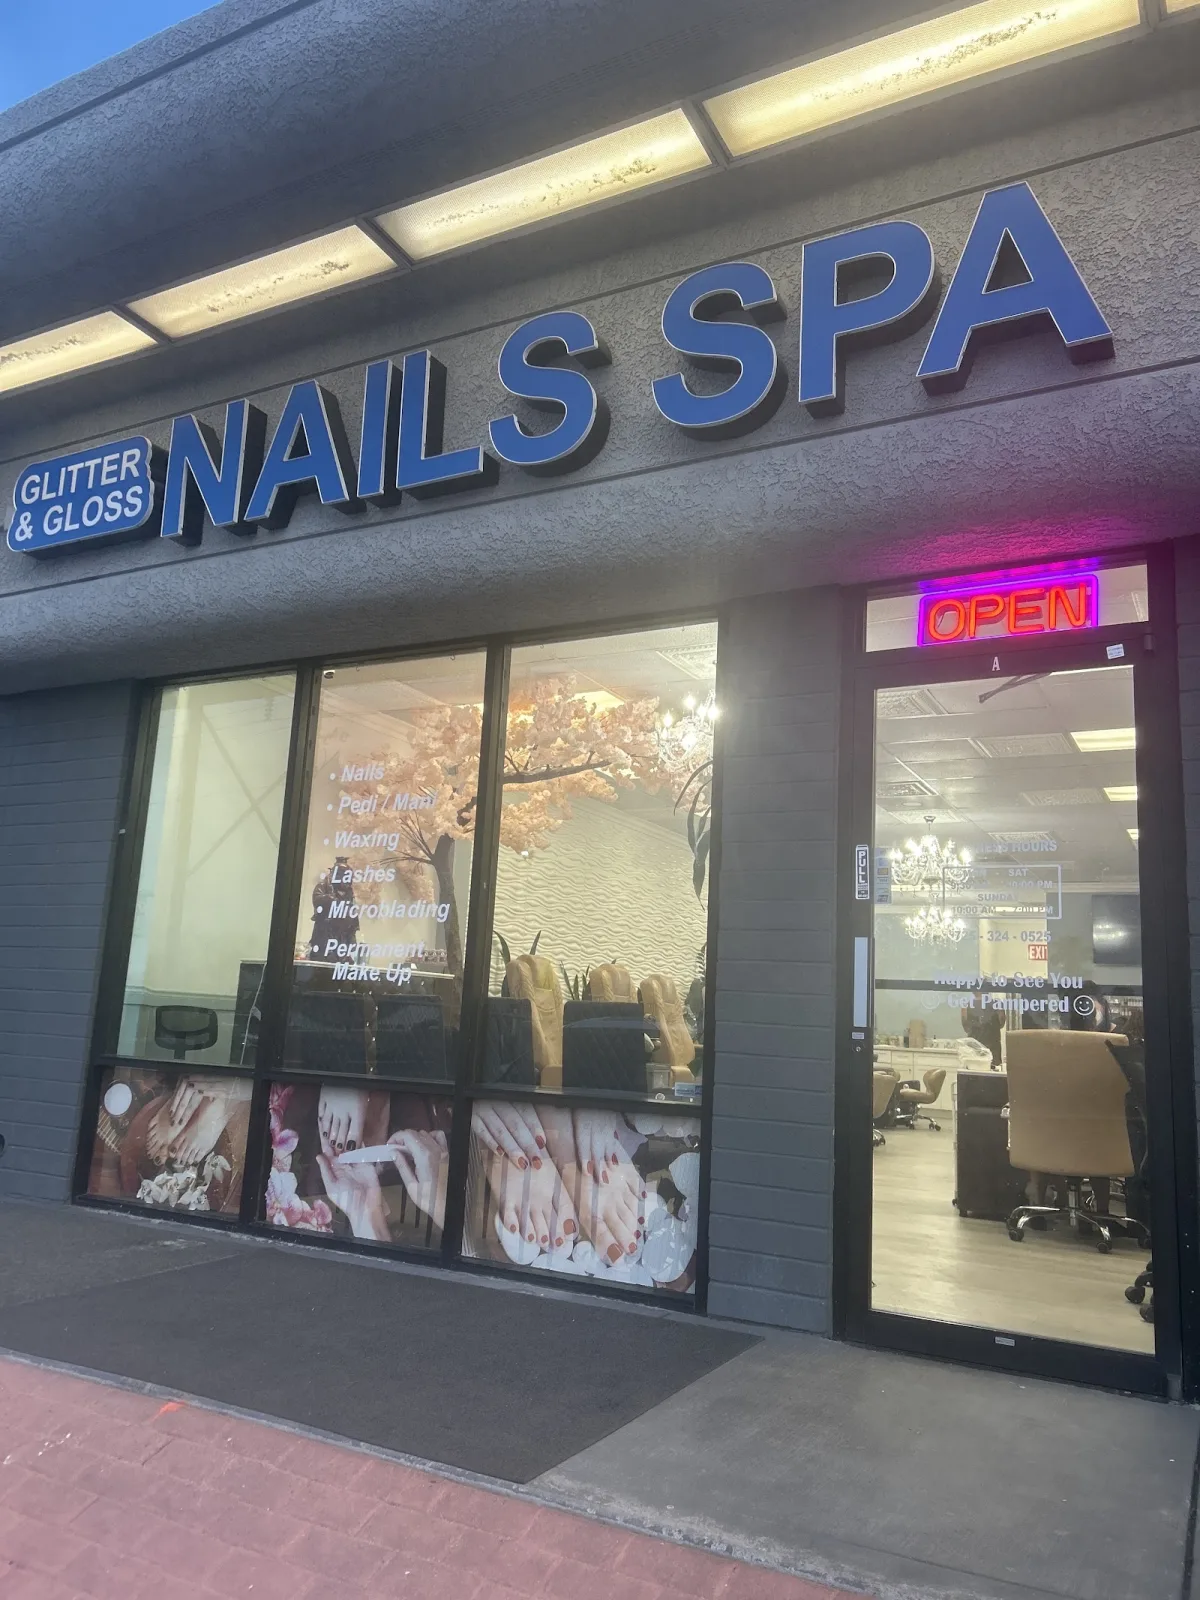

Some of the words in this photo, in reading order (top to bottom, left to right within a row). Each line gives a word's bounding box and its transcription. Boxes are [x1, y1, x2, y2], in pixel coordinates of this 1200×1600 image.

[161, 311, 600, 538] NAILS
[651, 181, 1113, 428] SPA
[20, 448, 141, 505] GLITTER
[14, 511, 33, 542] &
[43, 485, 143, 536] GLOSS
[927, 582, 1087, 641] OPEN
[991, 656, 1001, 672] A
[341, 764, 385, 782] Nails
[338, 794, 378, 814] Pedi
[392, 792, 438, 811] Mani
[334, 831, 400, 851] Waxing
[1012, 839, 1057, 852] HOURS
[331, 865, 396, 884] Lashes
[858, 850, 867, 883] PULL
[1008, 868, 1029, 877] SAT
[1037, 880, 1053, 889] PM
[978, 893, 1018, 903] SUNDA
[328, 900, 450, 923] Microblading
[987, 930, 1010, 942] 324
[1020, 930, 1052, 942] 0525
[324, 938, 425, 958] Permanent
[332, 962, 380, 982] Make
[386, 962, 412, 986] Up
[991, 972, 1008, 988] to
[1013, 972, 1045, 988] See
[1050, 972, 1083, 989] You
[947, 993, 976, 1009] Get
[981, 993, 1069, 1015] Pampered
